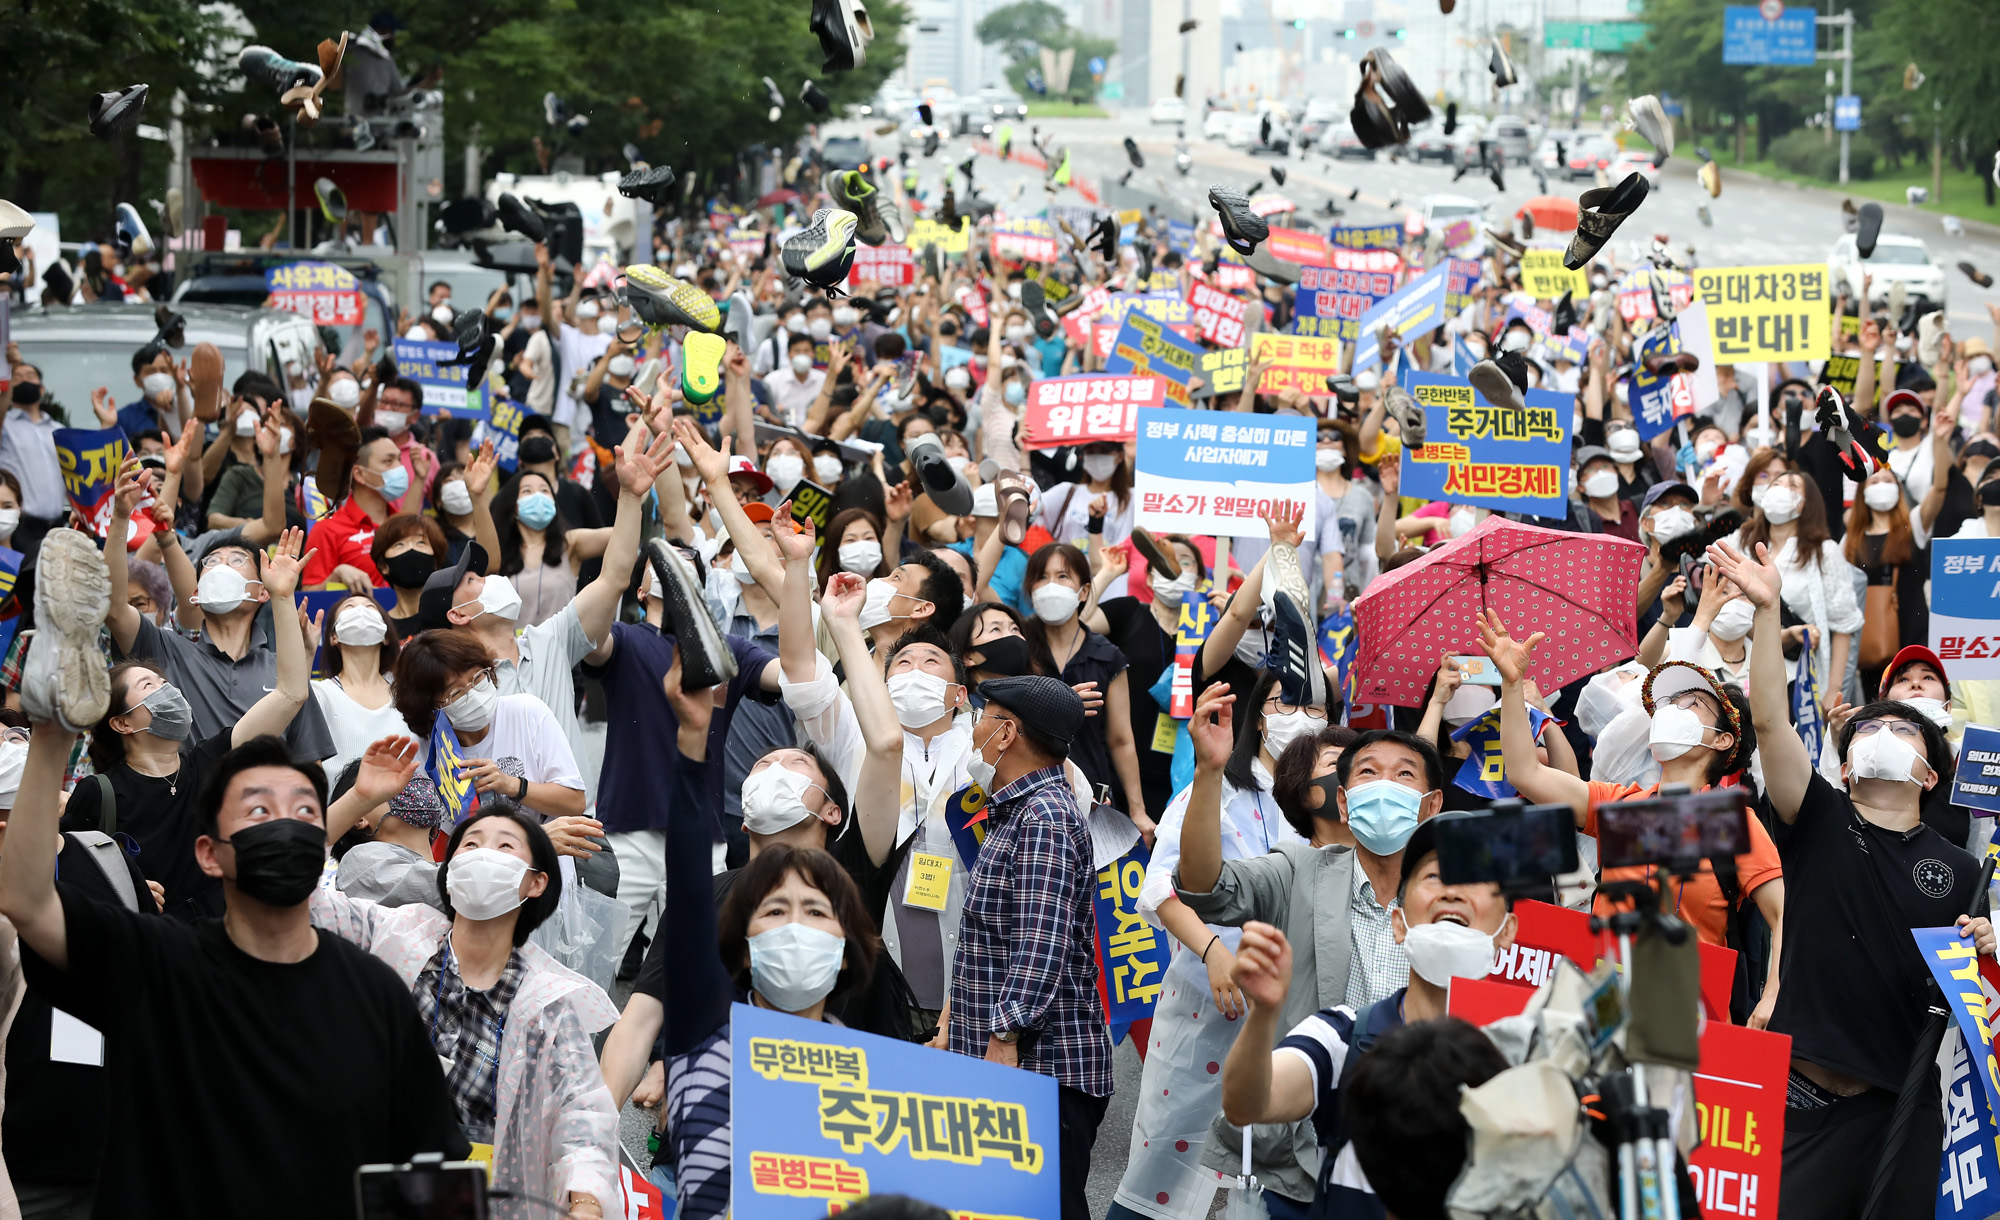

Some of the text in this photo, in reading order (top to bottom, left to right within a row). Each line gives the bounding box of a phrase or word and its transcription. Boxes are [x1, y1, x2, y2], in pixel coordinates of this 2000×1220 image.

[1336, 227, 1399, 248] 사유재산
[271, 265, 355, 289] 사유재산
[1302, 267, 1390, 296] 임대차3법
[1534, 272, 1578, 293] 반대!
[1699, 271, 1822, 305] 임대차3법
[1715, 314, 1809, 354] 반대!
[1201, 350, 1250, 371] 임대
[1258, 339, 1336, 361] 소급 적용
[1038, 378, 1154, 405] 임대차3법
[1415, 386, 1472, 404] 무한반복
[1046, 403, 1138, 436] 위헌!
[1449, 408, 1561, 440] 주거대책,
[1146, 422, 1308, 448] 정부 시책 충실히 따른
[1184, 445, 1269, 467] 사업자에게
[1444, 464, 1557, 495] 서민경제!
[1142, 492, 1207, 517] 말소가
[1943, 555, 1986, 575] 정부
[1176, 602, 1210, 646] 산
[918, 857, 943, 869] 임대차
[919, 872, 936, 882] 3법!
[1098, 845, 1163, 1005] 유재산
[752, 1041, 861, 1081] 무한반복
[821, 1088, 1037, 1167] 주거대책,
[752, 1155, 862, 1195] 골병드는
